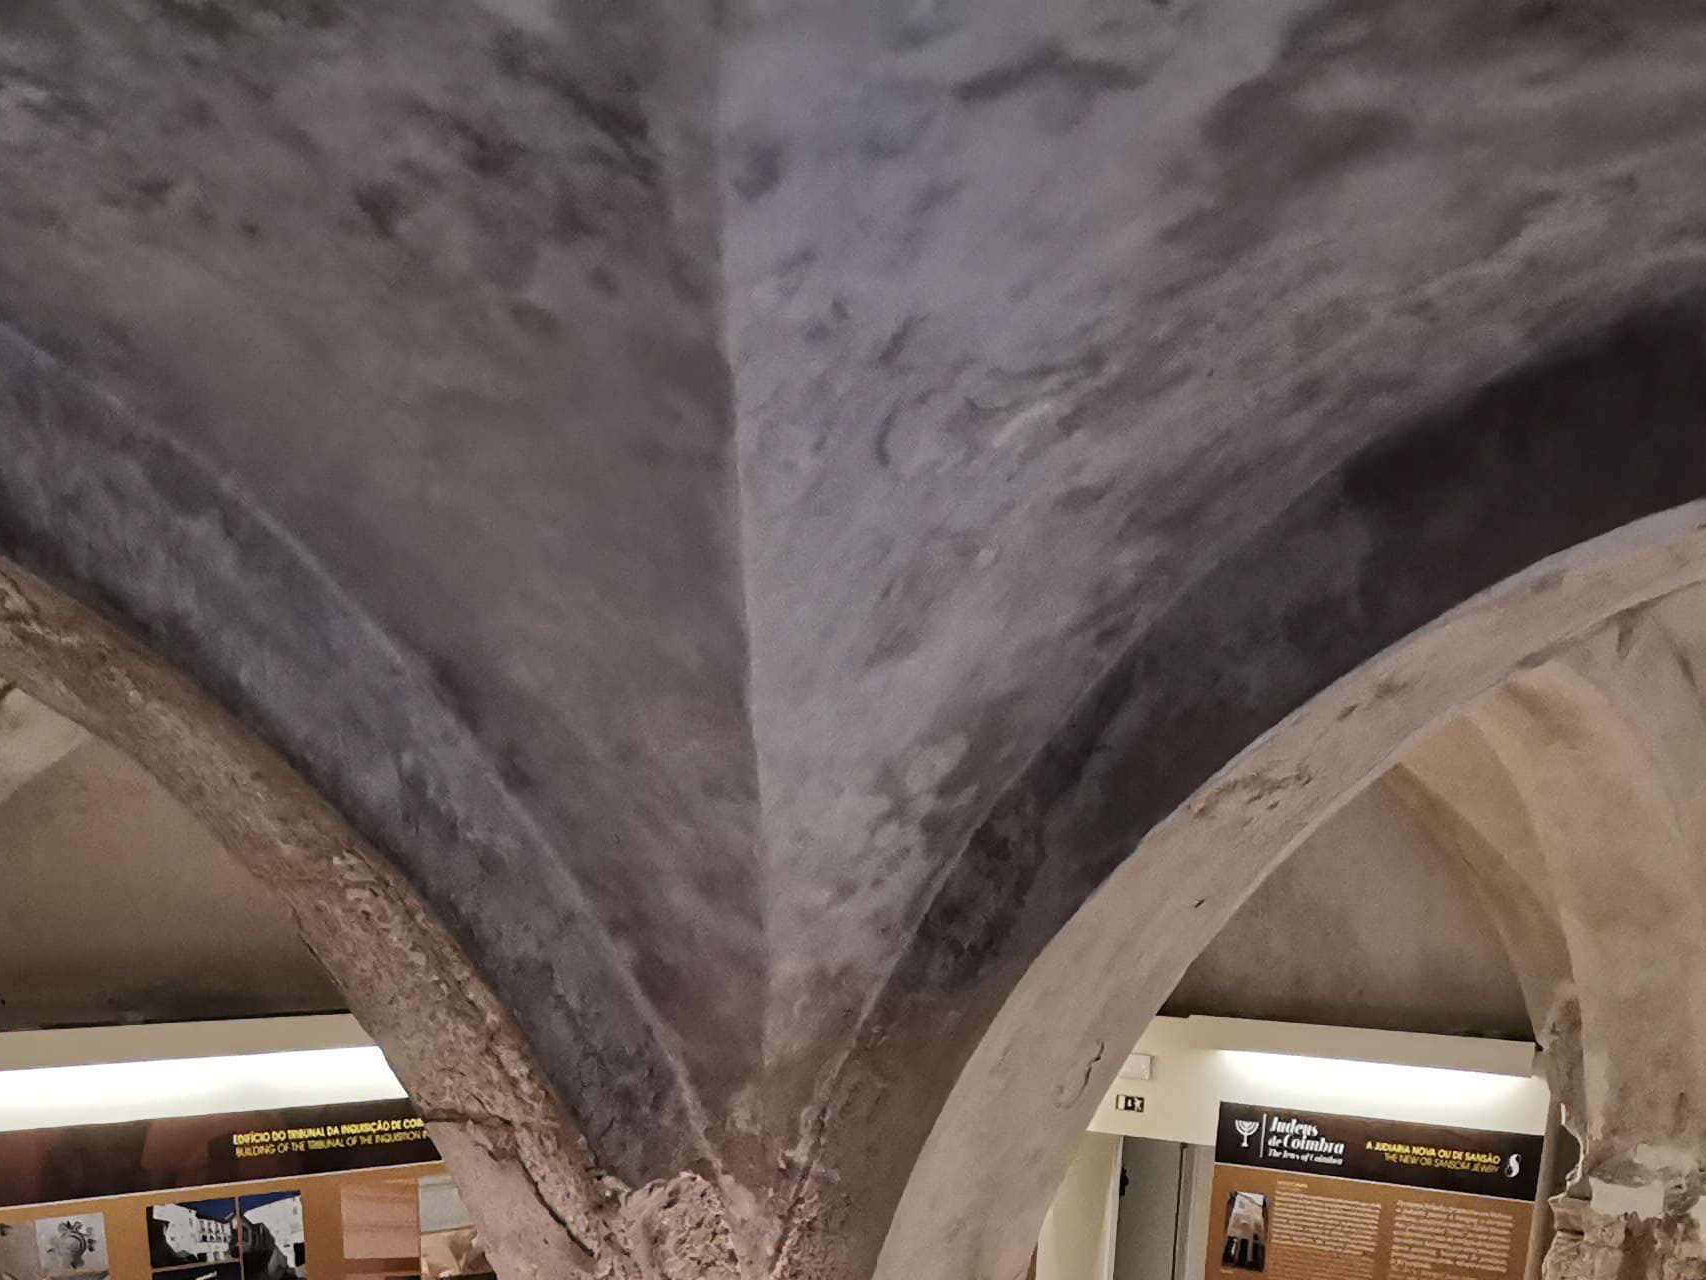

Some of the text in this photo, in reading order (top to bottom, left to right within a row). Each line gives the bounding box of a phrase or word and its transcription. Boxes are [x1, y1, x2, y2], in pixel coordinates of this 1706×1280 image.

[272, 1130, 286, 1141] DO
[287, 1127, 325, 1139] TRIBUNAL
[326, 1126, 340, 1136] DA
[391, 1120, 402, 1130] DE
[1269, 1117, 1319, 1136] Judeus
[277, 1142, 290, 1153] OF
[291, 1141, 306, 1151] THE
[346, 1136, 357, 1146] OF
[359, 1135, 373, 1144] THE
[1268, 1134, 1345, 1154] de Coimbra
[1365, 1140, 1373, 1149] A
[1411, 1146, 1436, 1157] NOVA
[1437, 1149, 1452, 1159] OU
[1453, 1150, 1464, 1160] DE
[1268, 1148, 1282, 1157] The
[1300, 1153, 1310, 1162] of
[1384, 1152, 1397, 1162] THE
[1398, 1154, 1420, 1164] NEW
